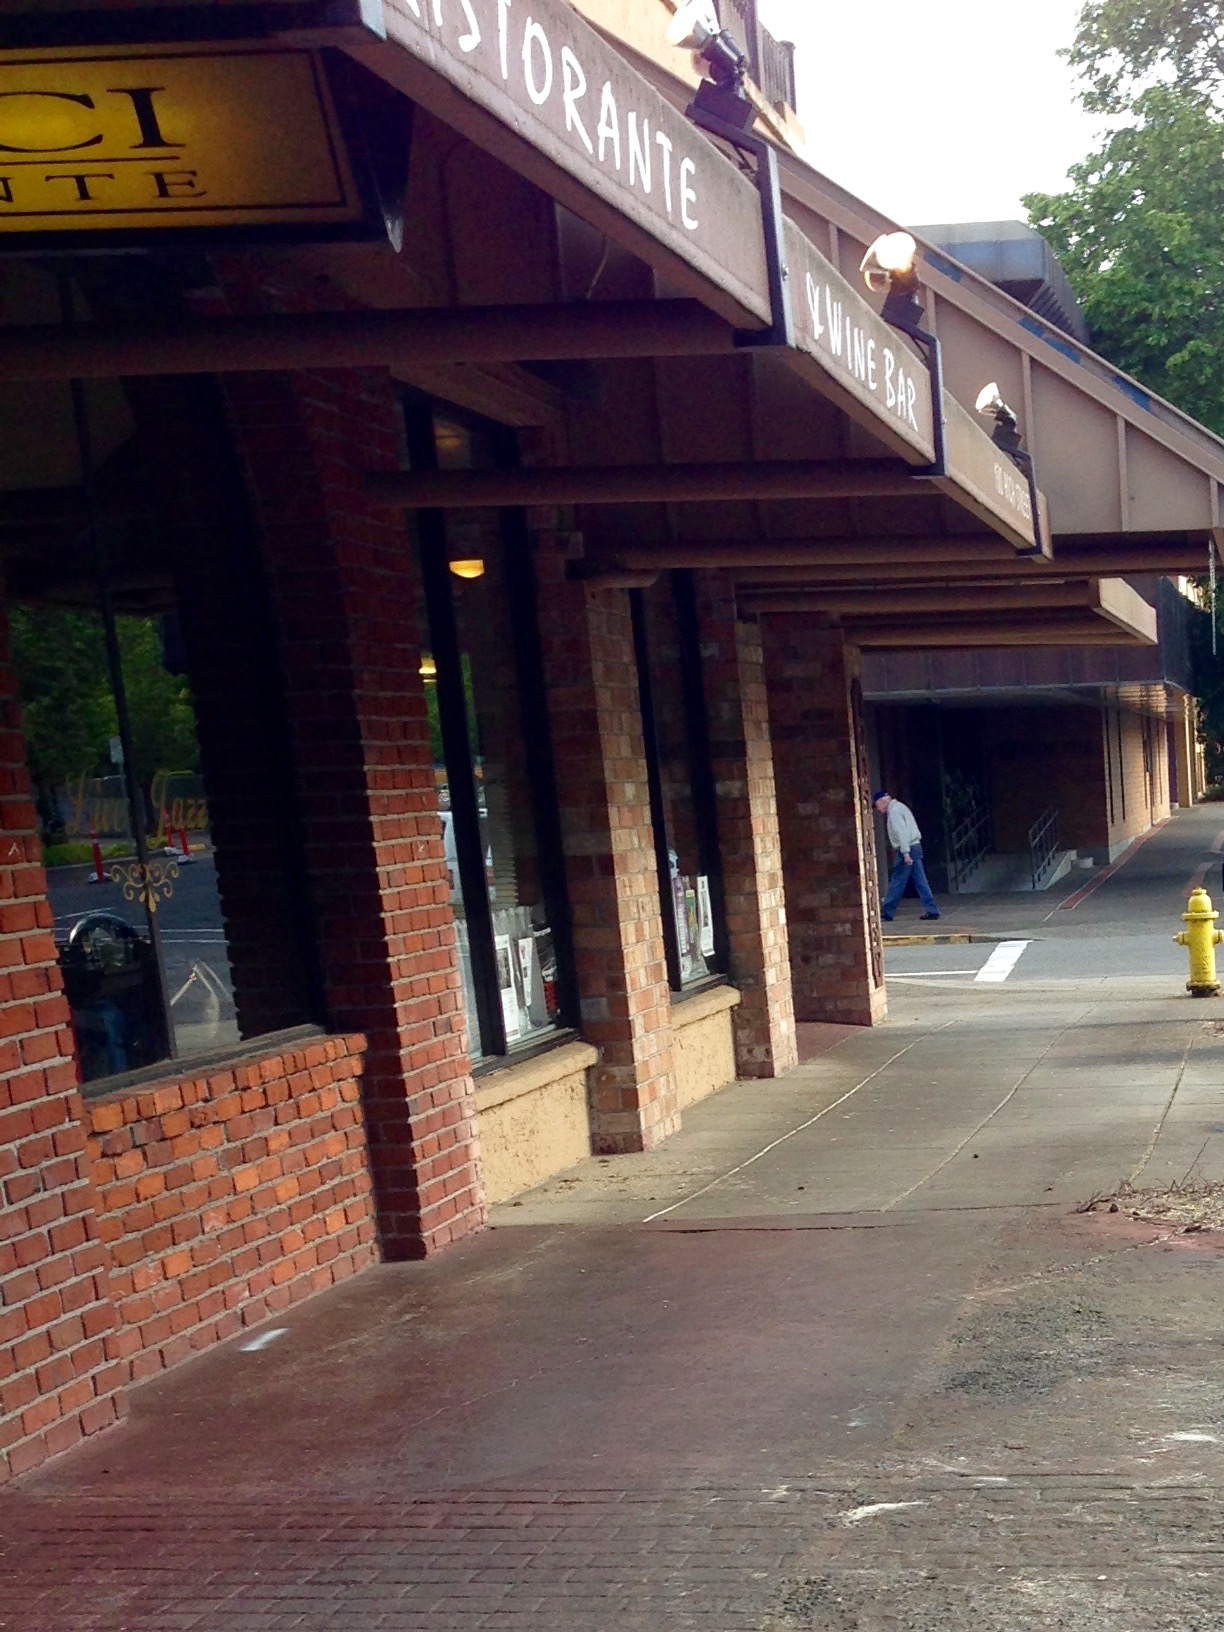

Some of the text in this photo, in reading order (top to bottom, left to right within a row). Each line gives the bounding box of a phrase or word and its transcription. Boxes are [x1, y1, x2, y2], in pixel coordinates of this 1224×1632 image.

[0, 169, 207, 203] TE
[825, 283, 877, 391] WINE
[883, 347, 919, 432] BAR
